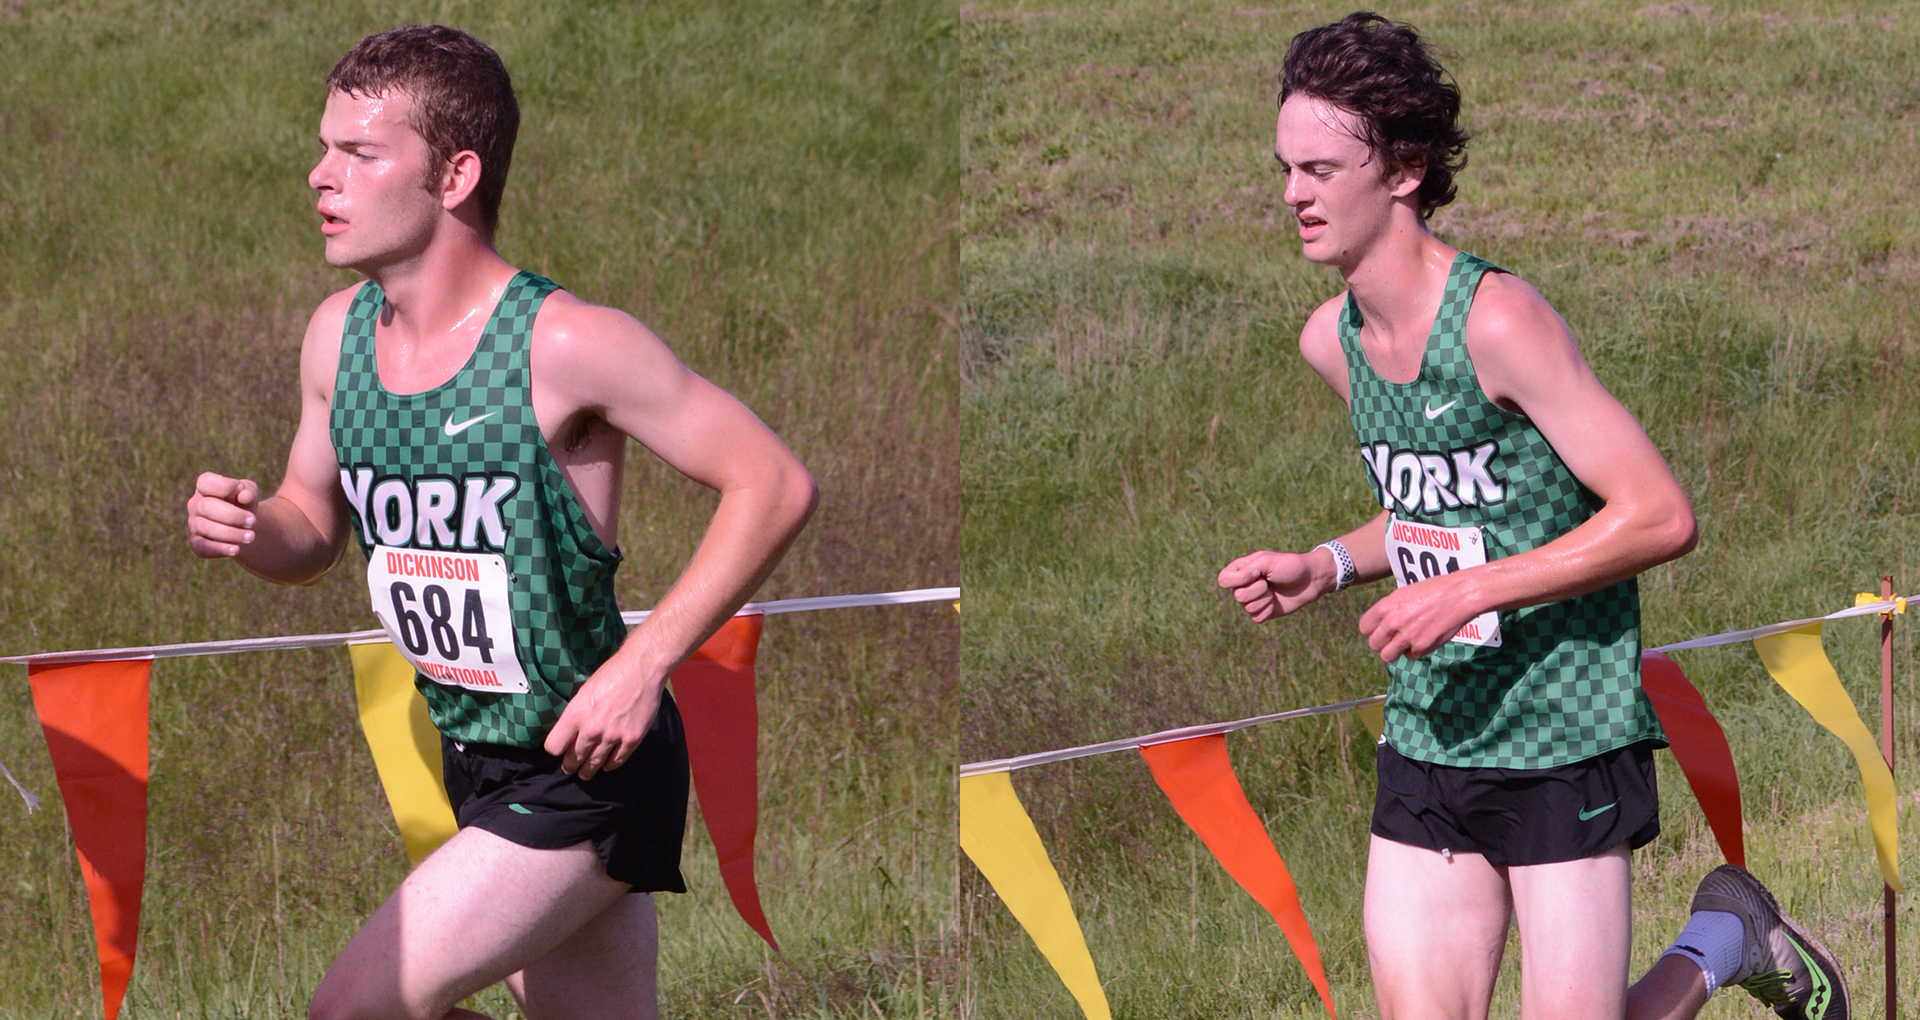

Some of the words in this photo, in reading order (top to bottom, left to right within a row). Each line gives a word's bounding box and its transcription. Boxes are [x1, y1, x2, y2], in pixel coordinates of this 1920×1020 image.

[1361, 440, 1507, 516] YORK
[340, 464, 519, 549] YORK
[1392, 522, 1461, 551] DICKINSON
[386, 551, 480, 582] DICKINSON
[390, 581, 494, 664] 684
[415, 660, 503, 686] INVITATIONAL
